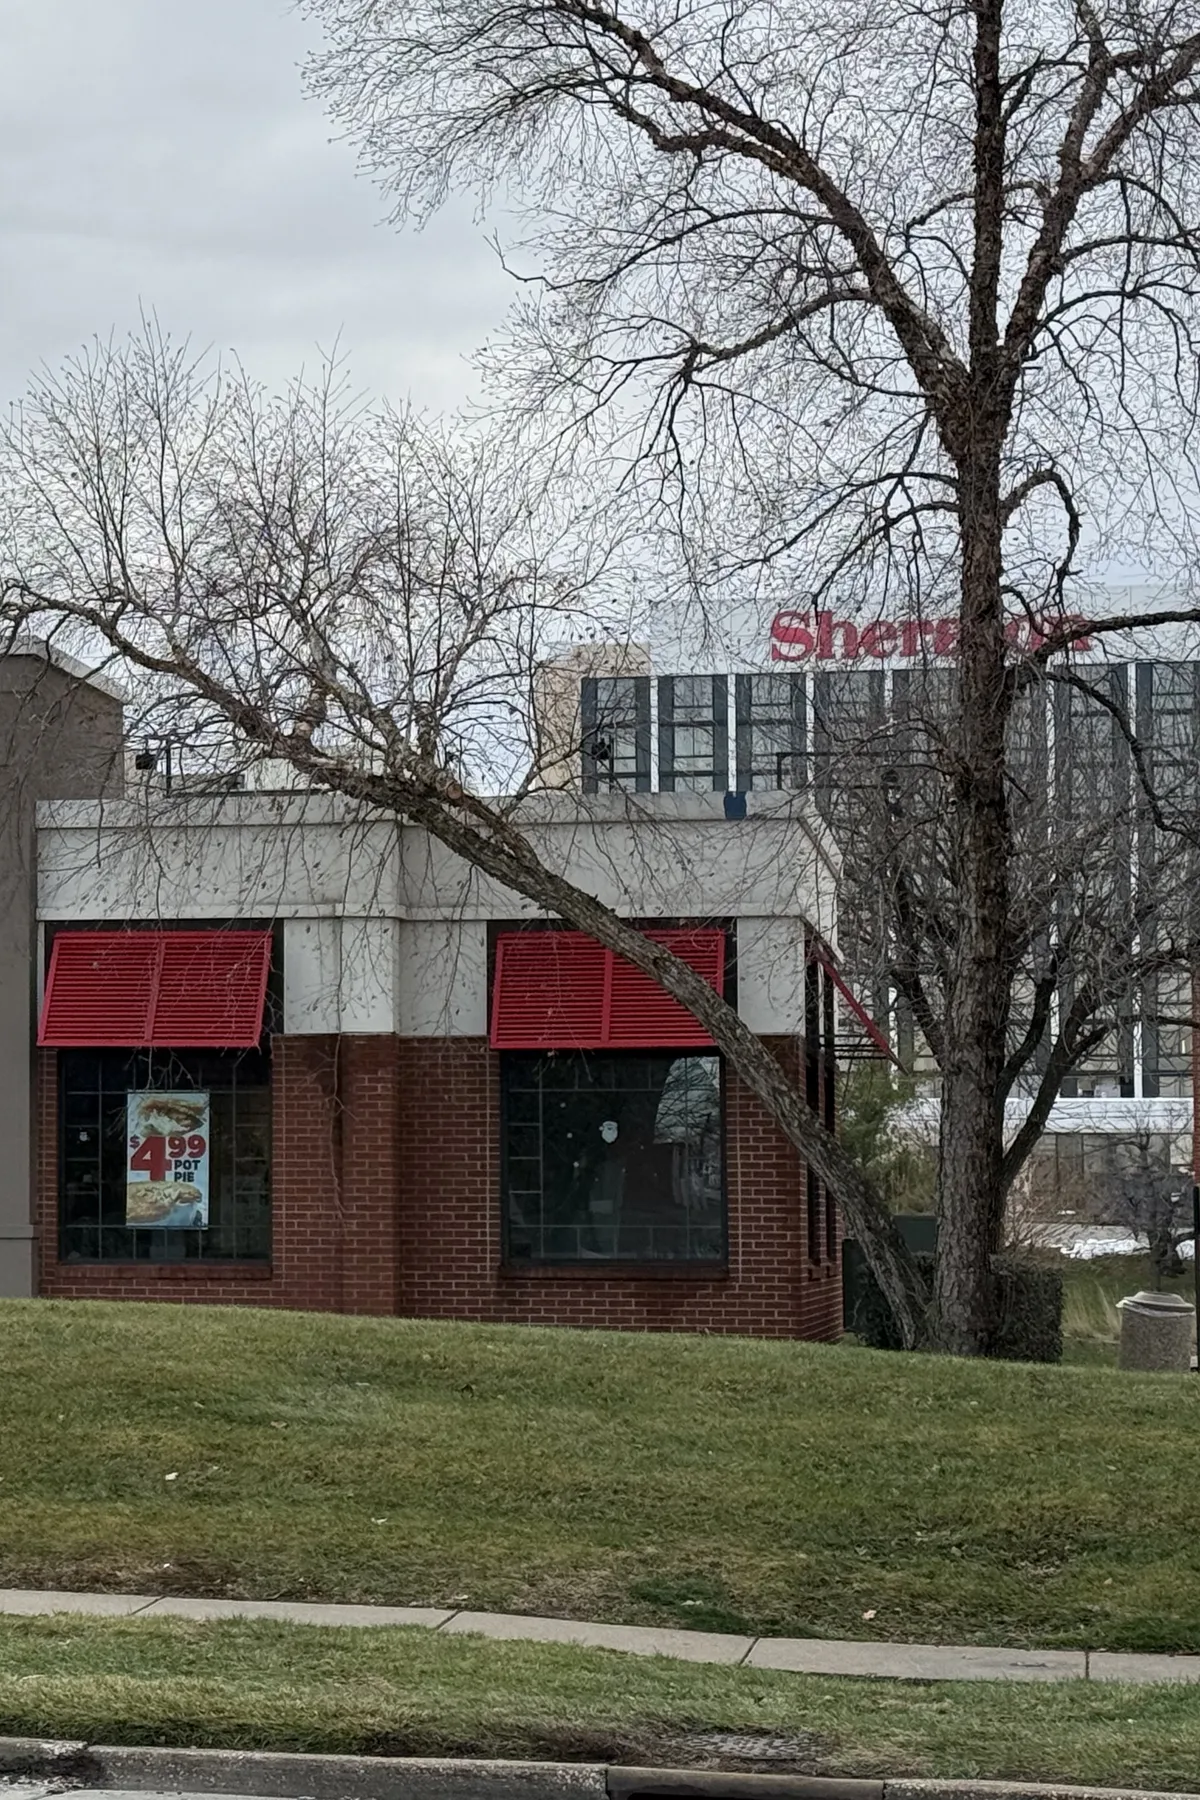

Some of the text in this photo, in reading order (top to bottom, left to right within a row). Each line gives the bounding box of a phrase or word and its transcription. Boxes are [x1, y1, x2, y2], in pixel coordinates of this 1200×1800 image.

[771, 610, 1091, 661] Sheraon
[174, 1159, 201, 1171] POT
[174, 1171, 195, 1183] PIE
